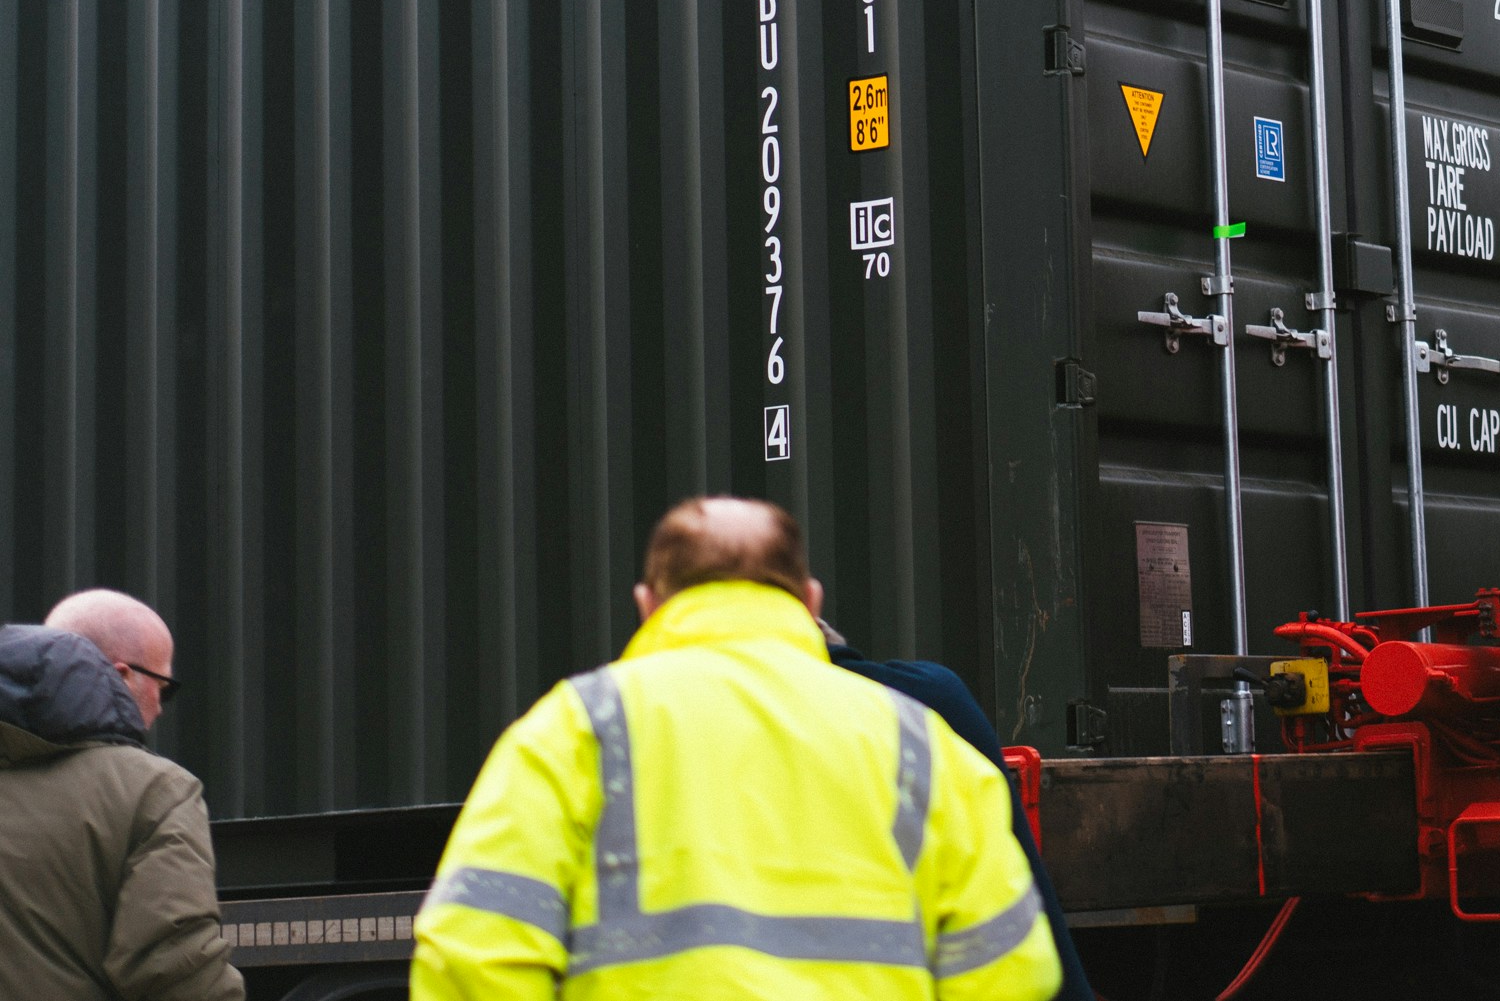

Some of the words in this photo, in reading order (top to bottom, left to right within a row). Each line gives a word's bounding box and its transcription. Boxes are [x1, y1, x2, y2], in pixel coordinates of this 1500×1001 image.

[1132, 90, 1154, 102] ATTENTION
[1266, 129, 1279, 157] LR
[1426, 162, 1466, 211] TARE
[761, 86, 785, 385] 209376
[1427, 206, 1494, 261] PAYLOAD
[862, 252, 890, 279] 70
[766, 407, 788, 458] 4
[1437, 404, 1460, 450] CU.
